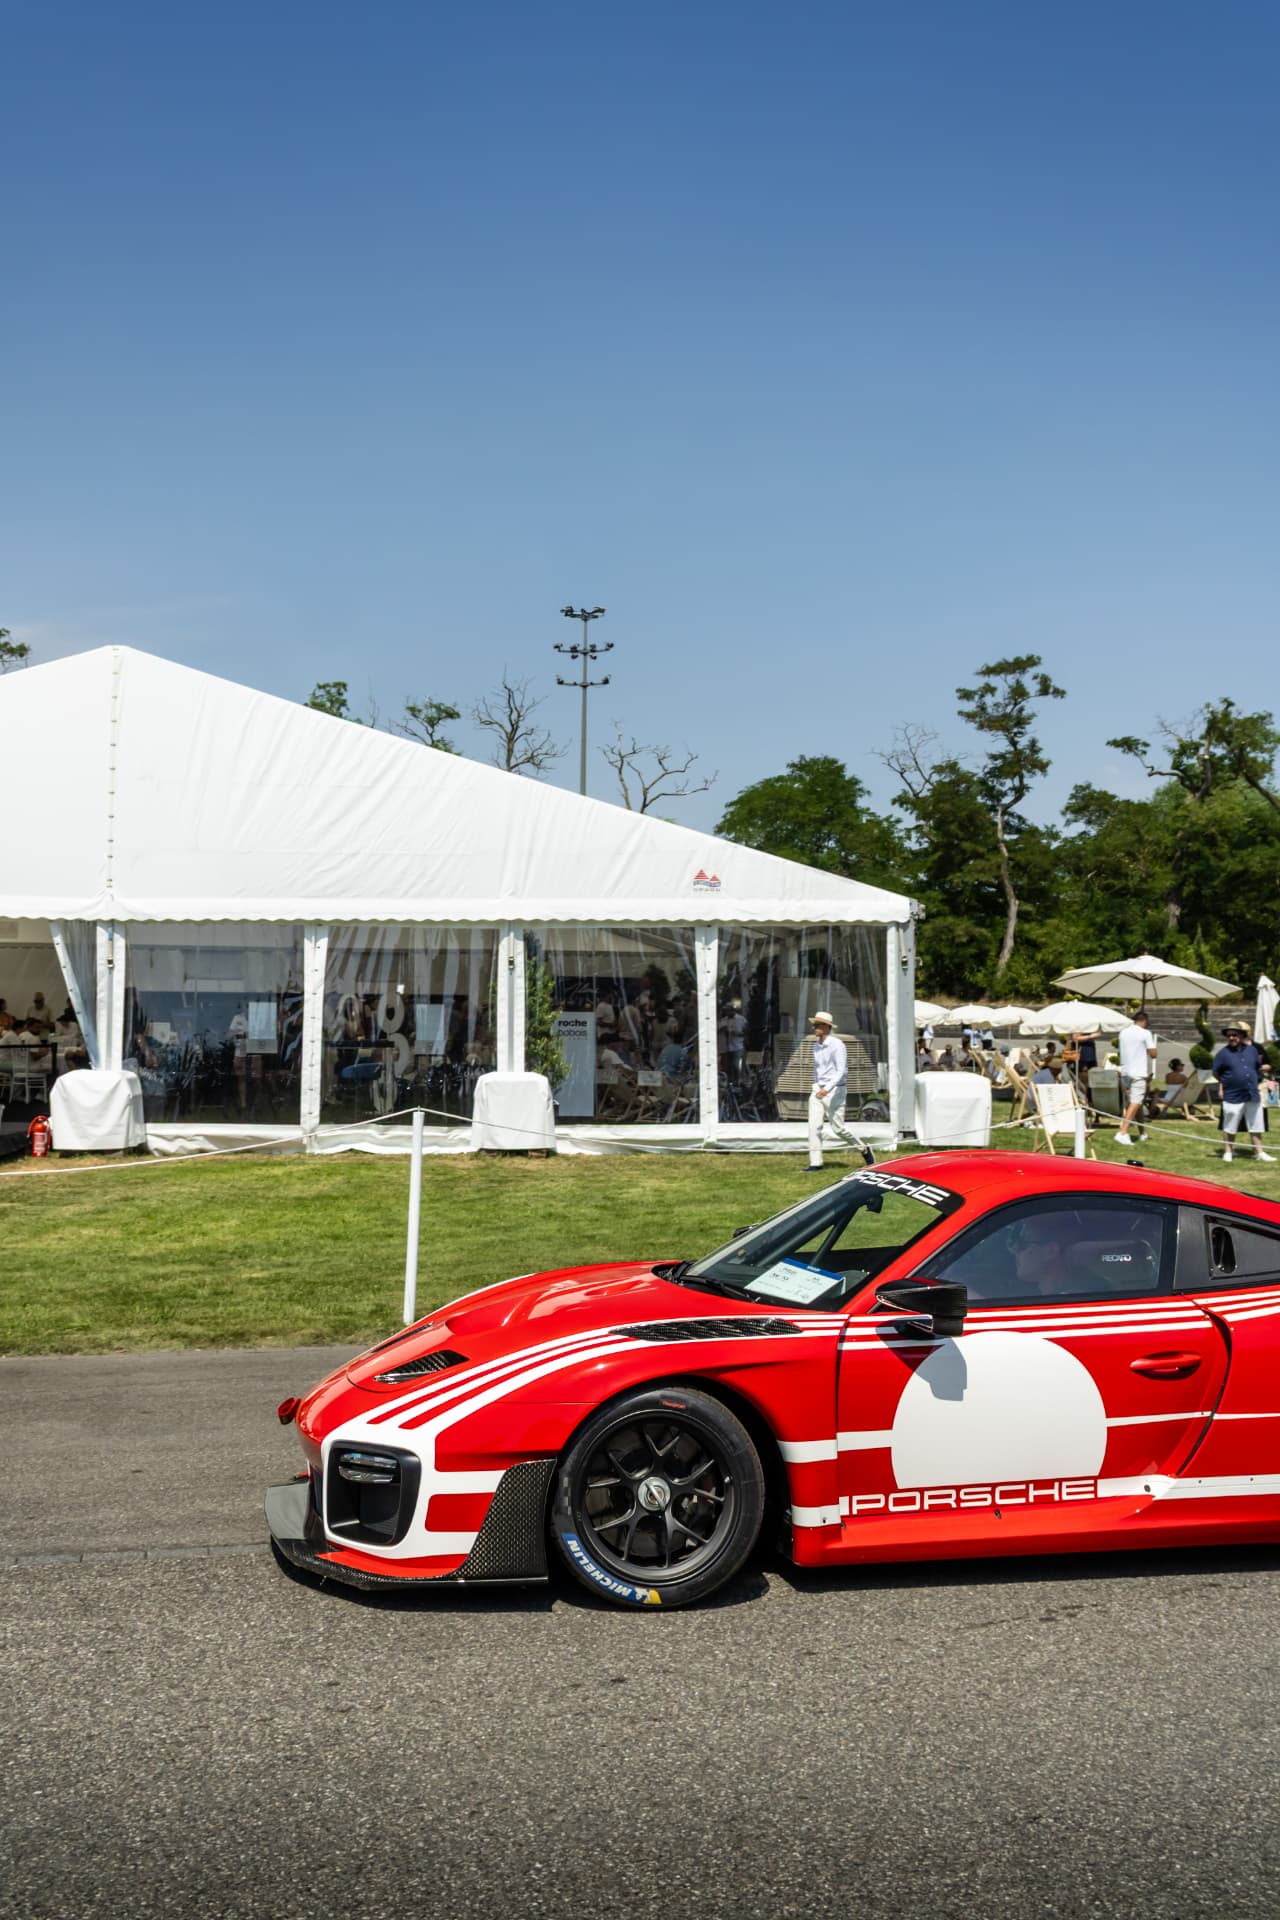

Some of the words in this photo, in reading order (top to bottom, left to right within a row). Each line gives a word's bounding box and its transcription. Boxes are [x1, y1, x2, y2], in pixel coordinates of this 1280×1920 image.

[558, 1018, 588, 1027] roche
[851, 1479, 1096, 1515] PORSCHE
[567, 1540, 633, 1597] MICHELIN
